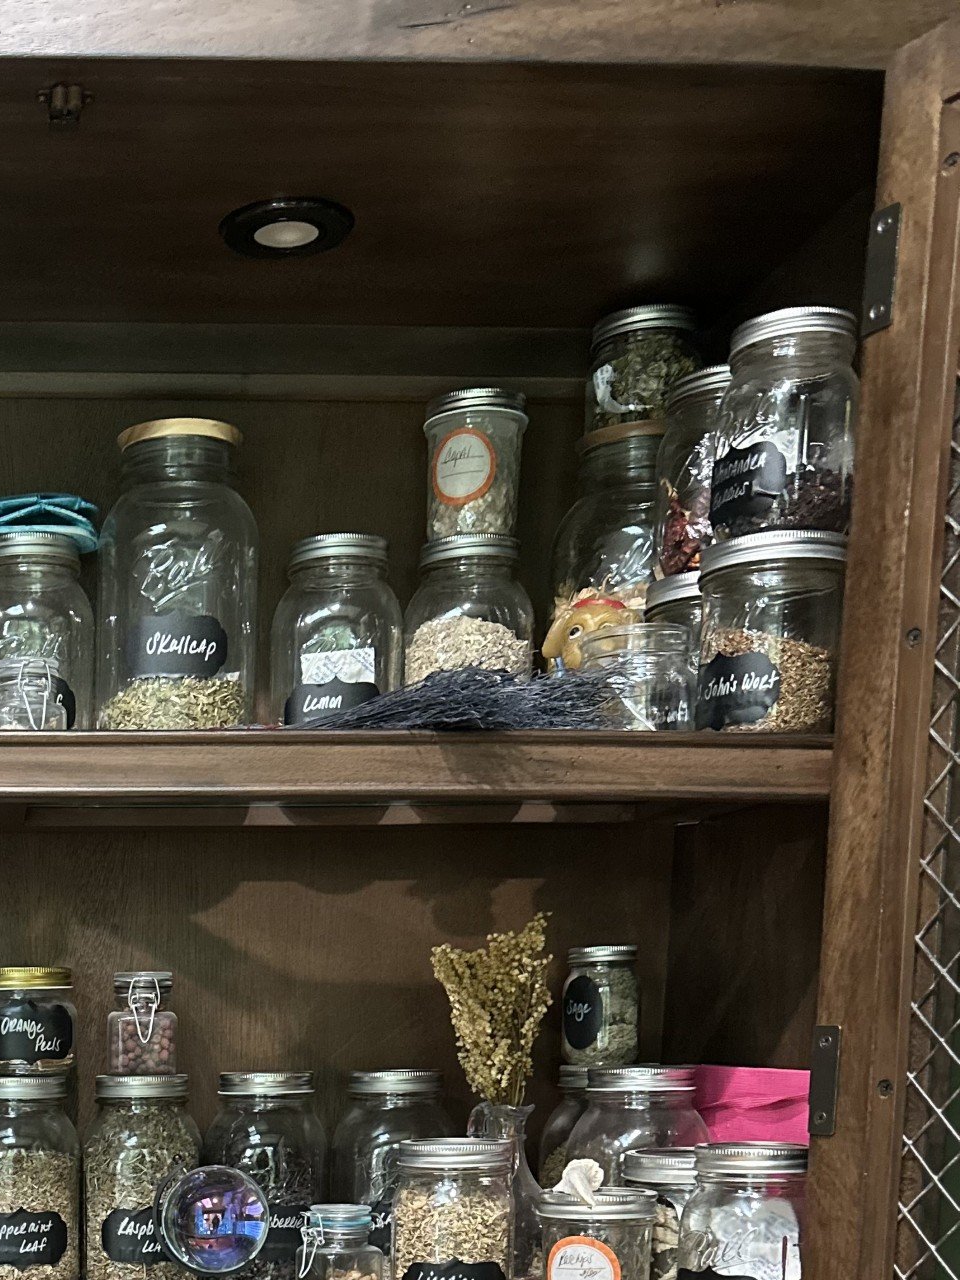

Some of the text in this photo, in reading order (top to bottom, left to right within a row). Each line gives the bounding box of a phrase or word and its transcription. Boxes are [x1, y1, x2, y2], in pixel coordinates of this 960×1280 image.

[704, 674, 737, 700] John's
[303, 695, 343, 713] Lemon
[566, 1000, 592, 1022] Sage
[35, 1034, 61, 1052] Peels
